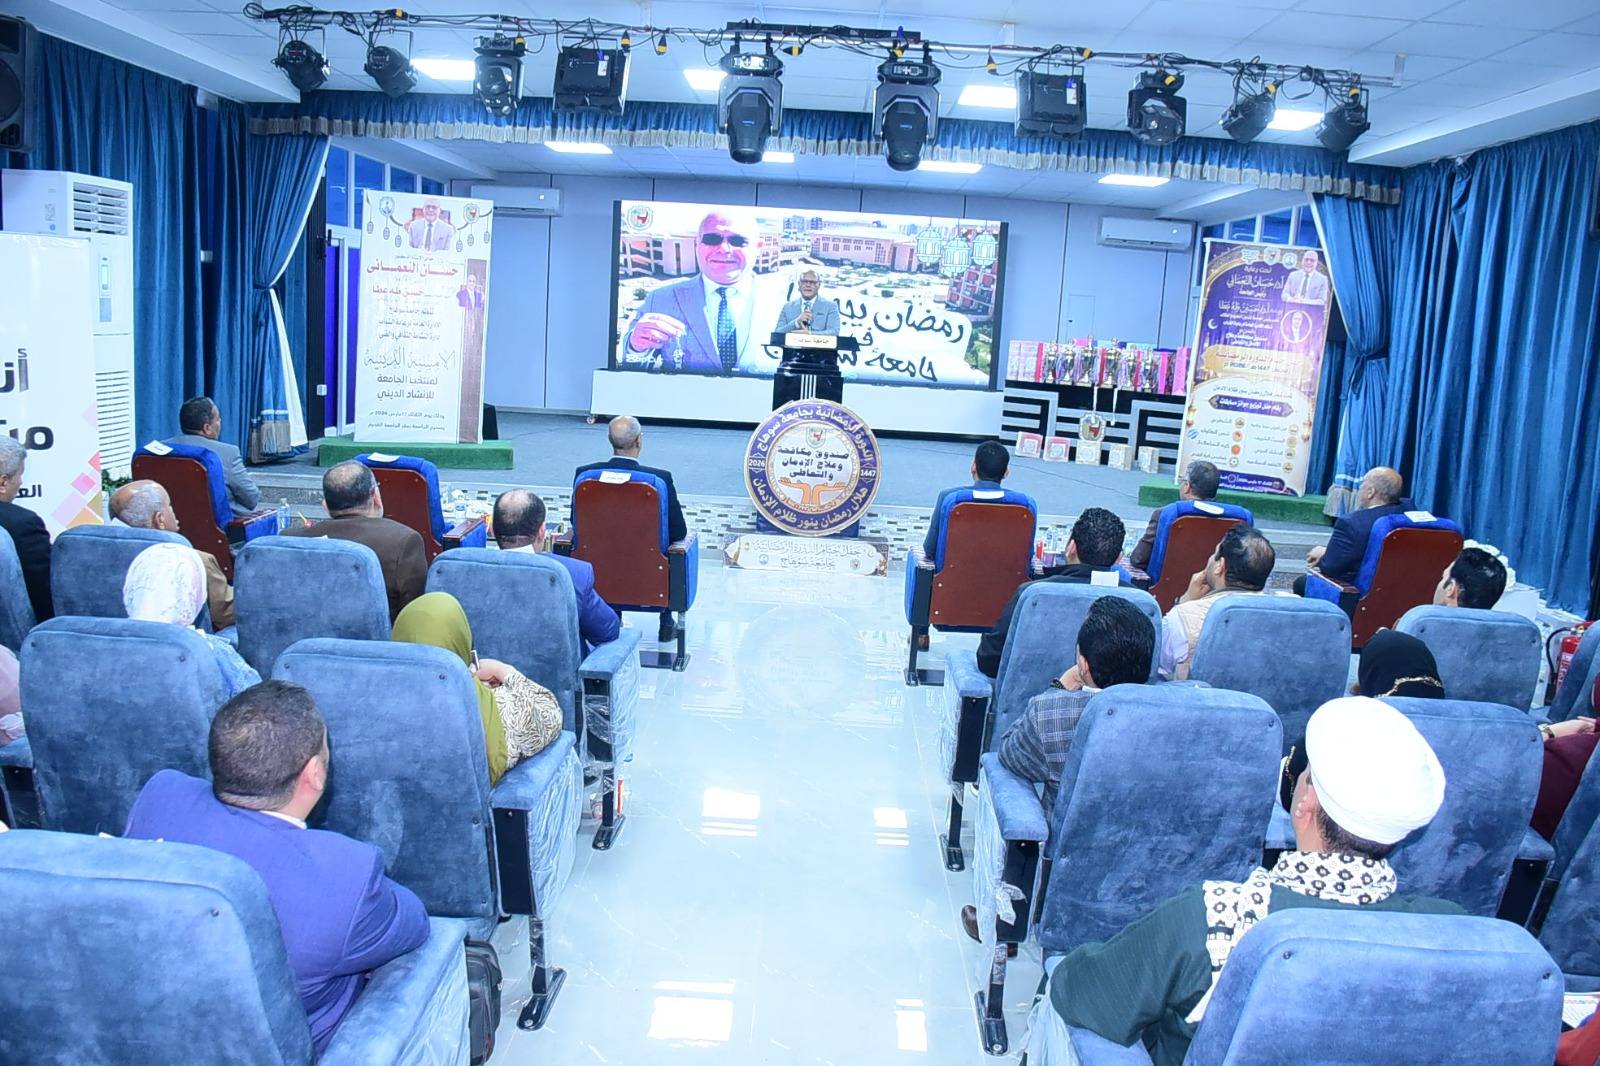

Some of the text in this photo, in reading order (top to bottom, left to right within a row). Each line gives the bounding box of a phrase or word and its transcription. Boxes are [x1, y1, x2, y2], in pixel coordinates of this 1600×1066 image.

[419, 264, 458, 277] حسان
[874, 300, 964, 343] رمضان
[865, 347, 938, 382] جامعة
[377, 373, 438, 385] لمنتخب الجامعة
[376, 389, 405, 402] الديني
[757, 406, 875, 462] الدورة الرمضانية بجامعة سوهاج
[777, 445, 849, 460] صندوق مكافحة
[749, 459, 766, 467] 2026
[817, 460, 843, 471] وعلاج
[861, 470, 877, 478] 1447
[851, 487, 869, 511] هلال
[773, 508, 798, 523] ظلام
[821, 508, 853, 528] رمضان
[798, 519, 819, 529] ينور
